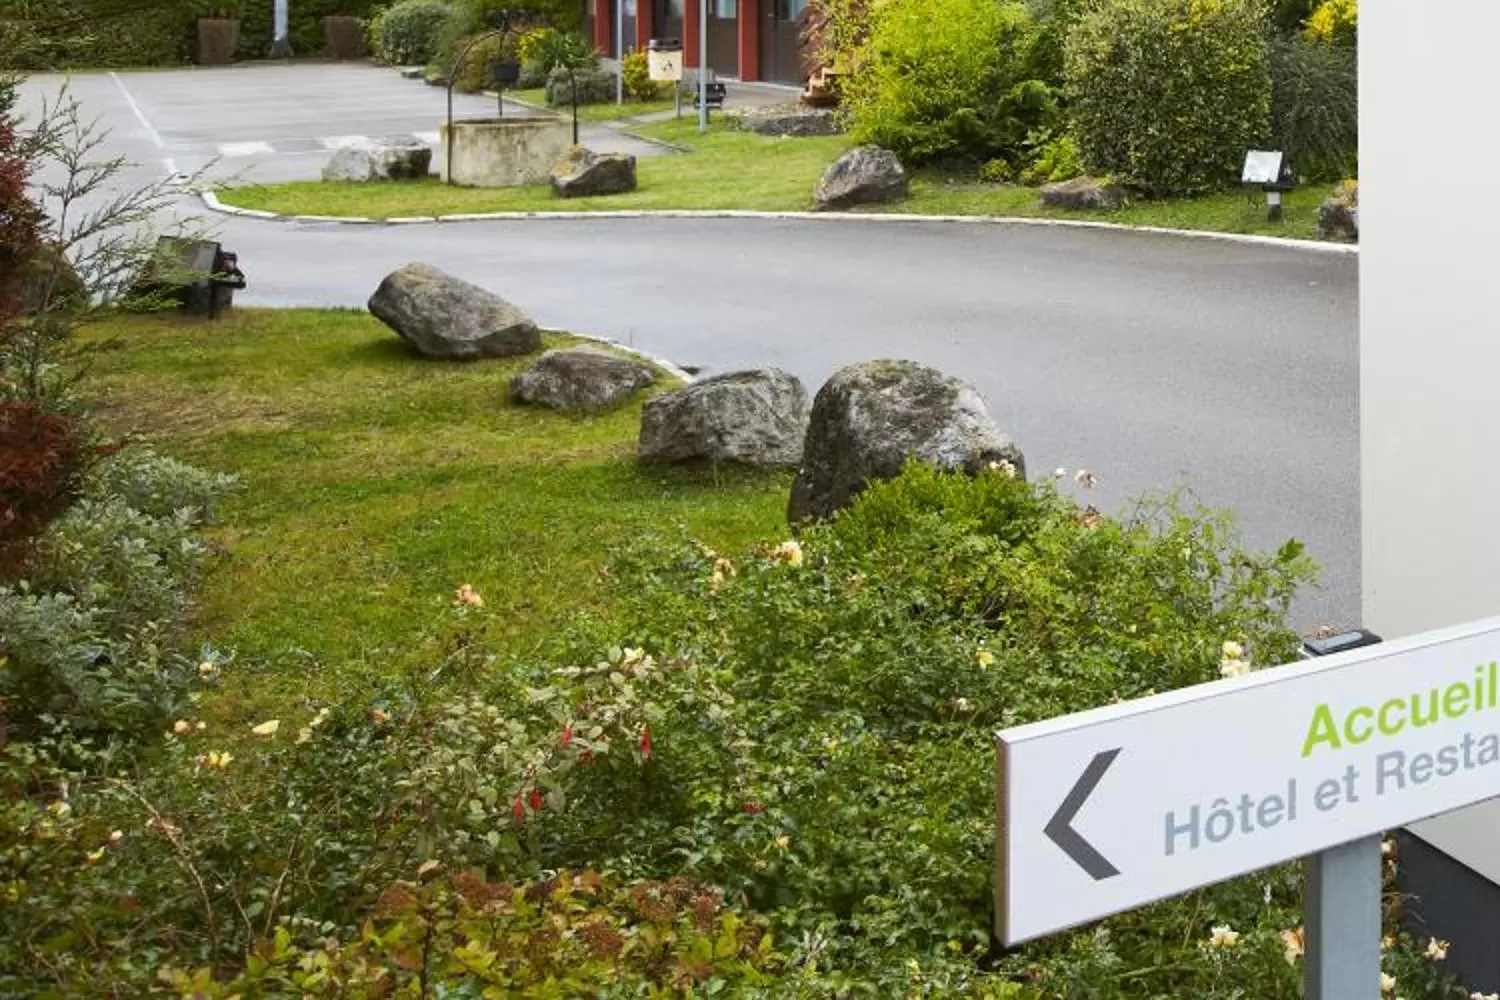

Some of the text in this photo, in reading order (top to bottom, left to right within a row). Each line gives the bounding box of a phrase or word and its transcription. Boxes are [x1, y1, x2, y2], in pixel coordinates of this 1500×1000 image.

[1301, 662, 1497, 758] Accueil
[1165, 778, 1297, 857] Hôtel
[1313, 765, 1360, 812] et
